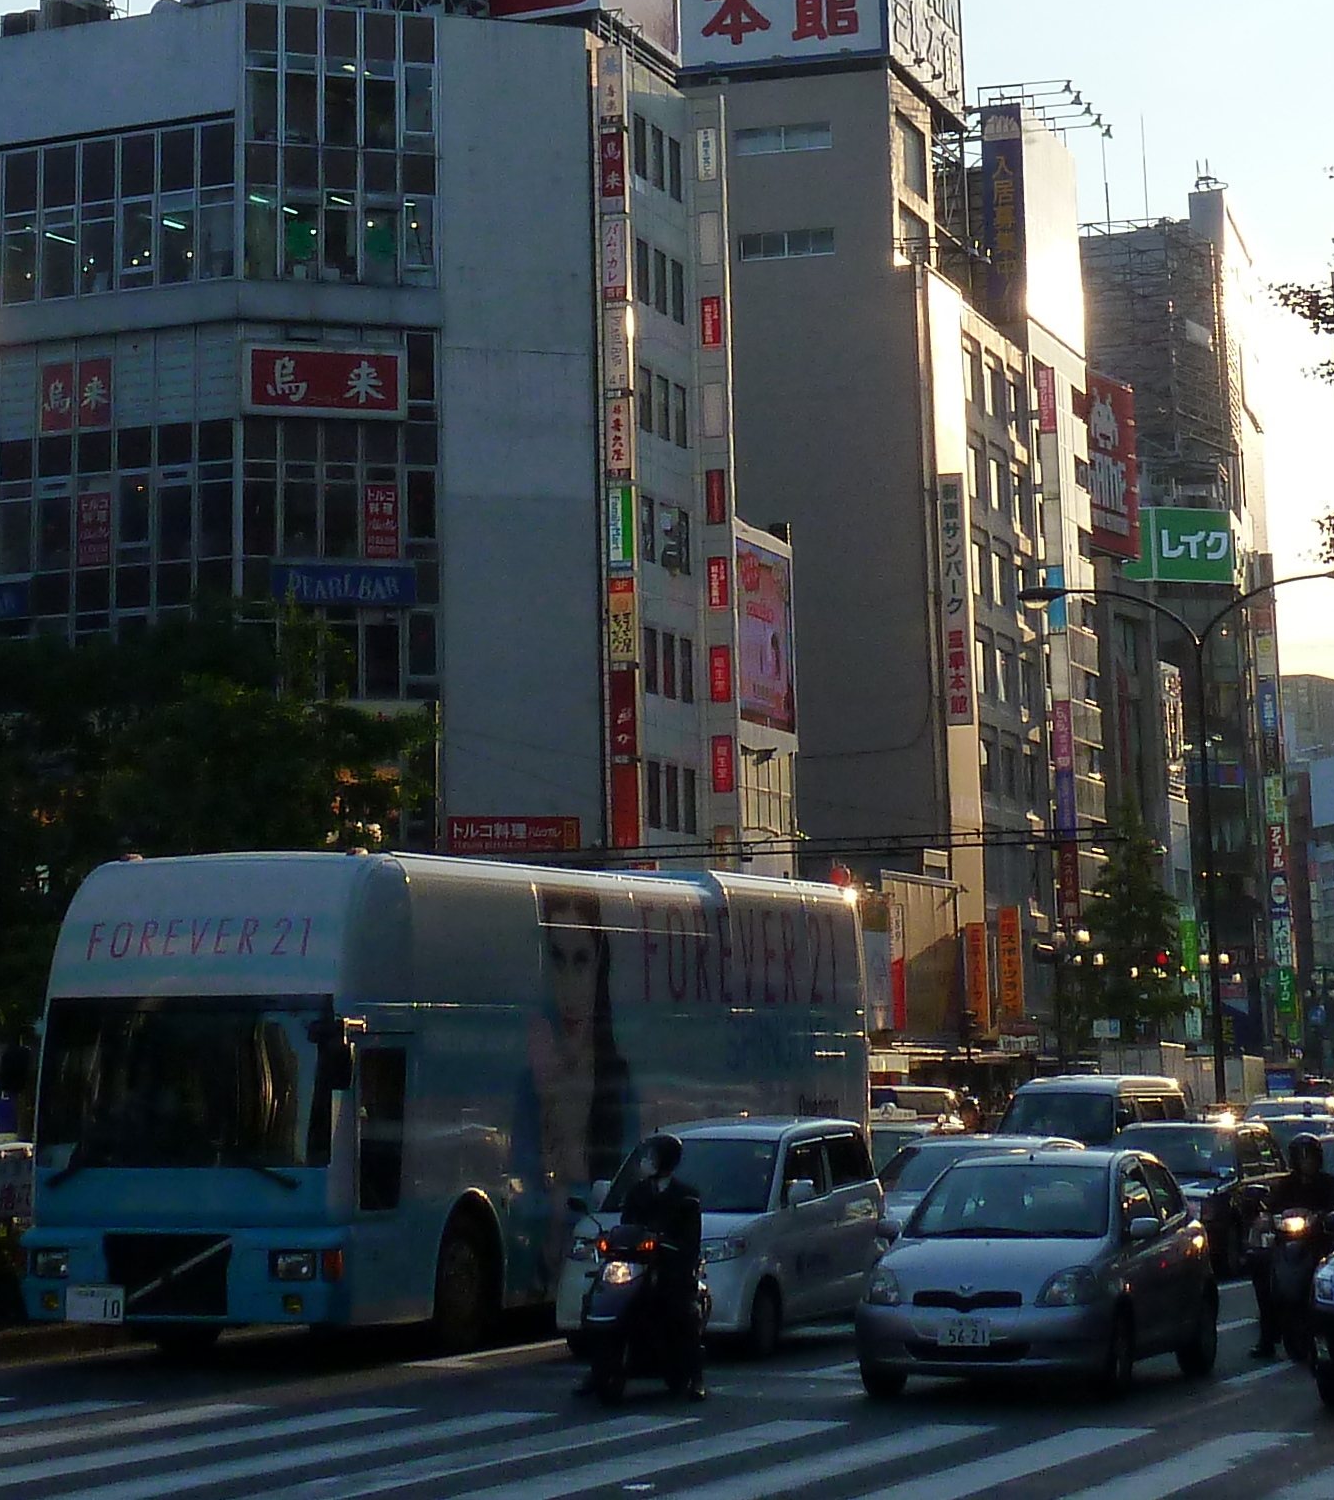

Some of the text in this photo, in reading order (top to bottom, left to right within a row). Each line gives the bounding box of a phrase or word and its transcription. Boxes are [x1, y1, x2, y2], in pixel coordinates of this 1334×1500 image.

[609, 495, 621, 551] FamilyMart
[1161, 530, 1229, 562] レイク
[288, 569, 402, 601] PEARL BAR
[452, 822, 527, 840] トルコ料理
[1270, 825, 1284, 868] アイフル
[85, 916, 313, 963] FOREVER 21
[640, 903, 839, 1004] FOREVER 21
[103, 1298, 121, 1320] 10
[947, 1328, 986, 1344] 56-21
